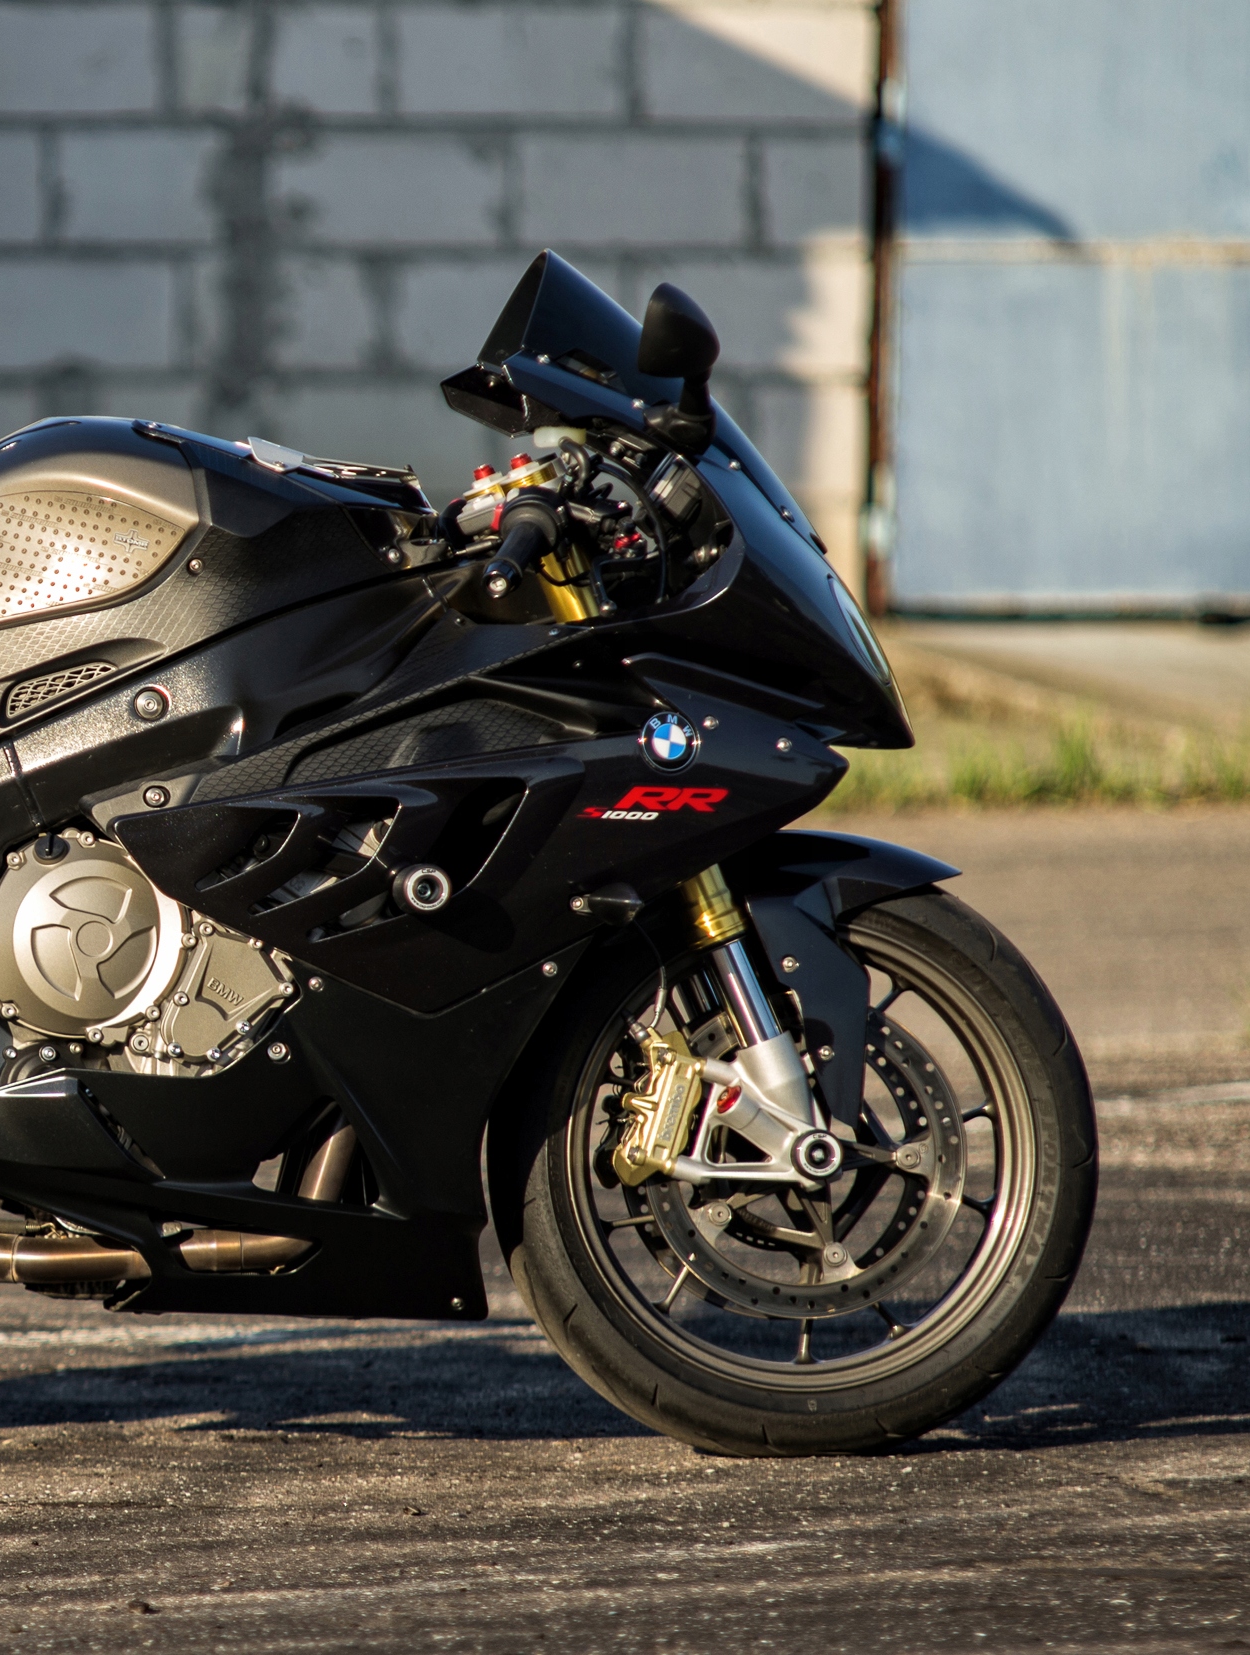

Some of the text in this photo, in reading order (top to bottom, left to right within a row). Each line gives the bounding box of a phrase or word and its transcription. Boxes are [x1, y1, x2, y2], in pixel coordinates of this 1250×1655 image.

[650, 714, 693, 737] BMW
[613, 786, 729, 812] RR
[577, 807, 659, 820] S1000
[207, 977, 244, 1006] BMW
[658, 1084, 686, 1141] brembo
